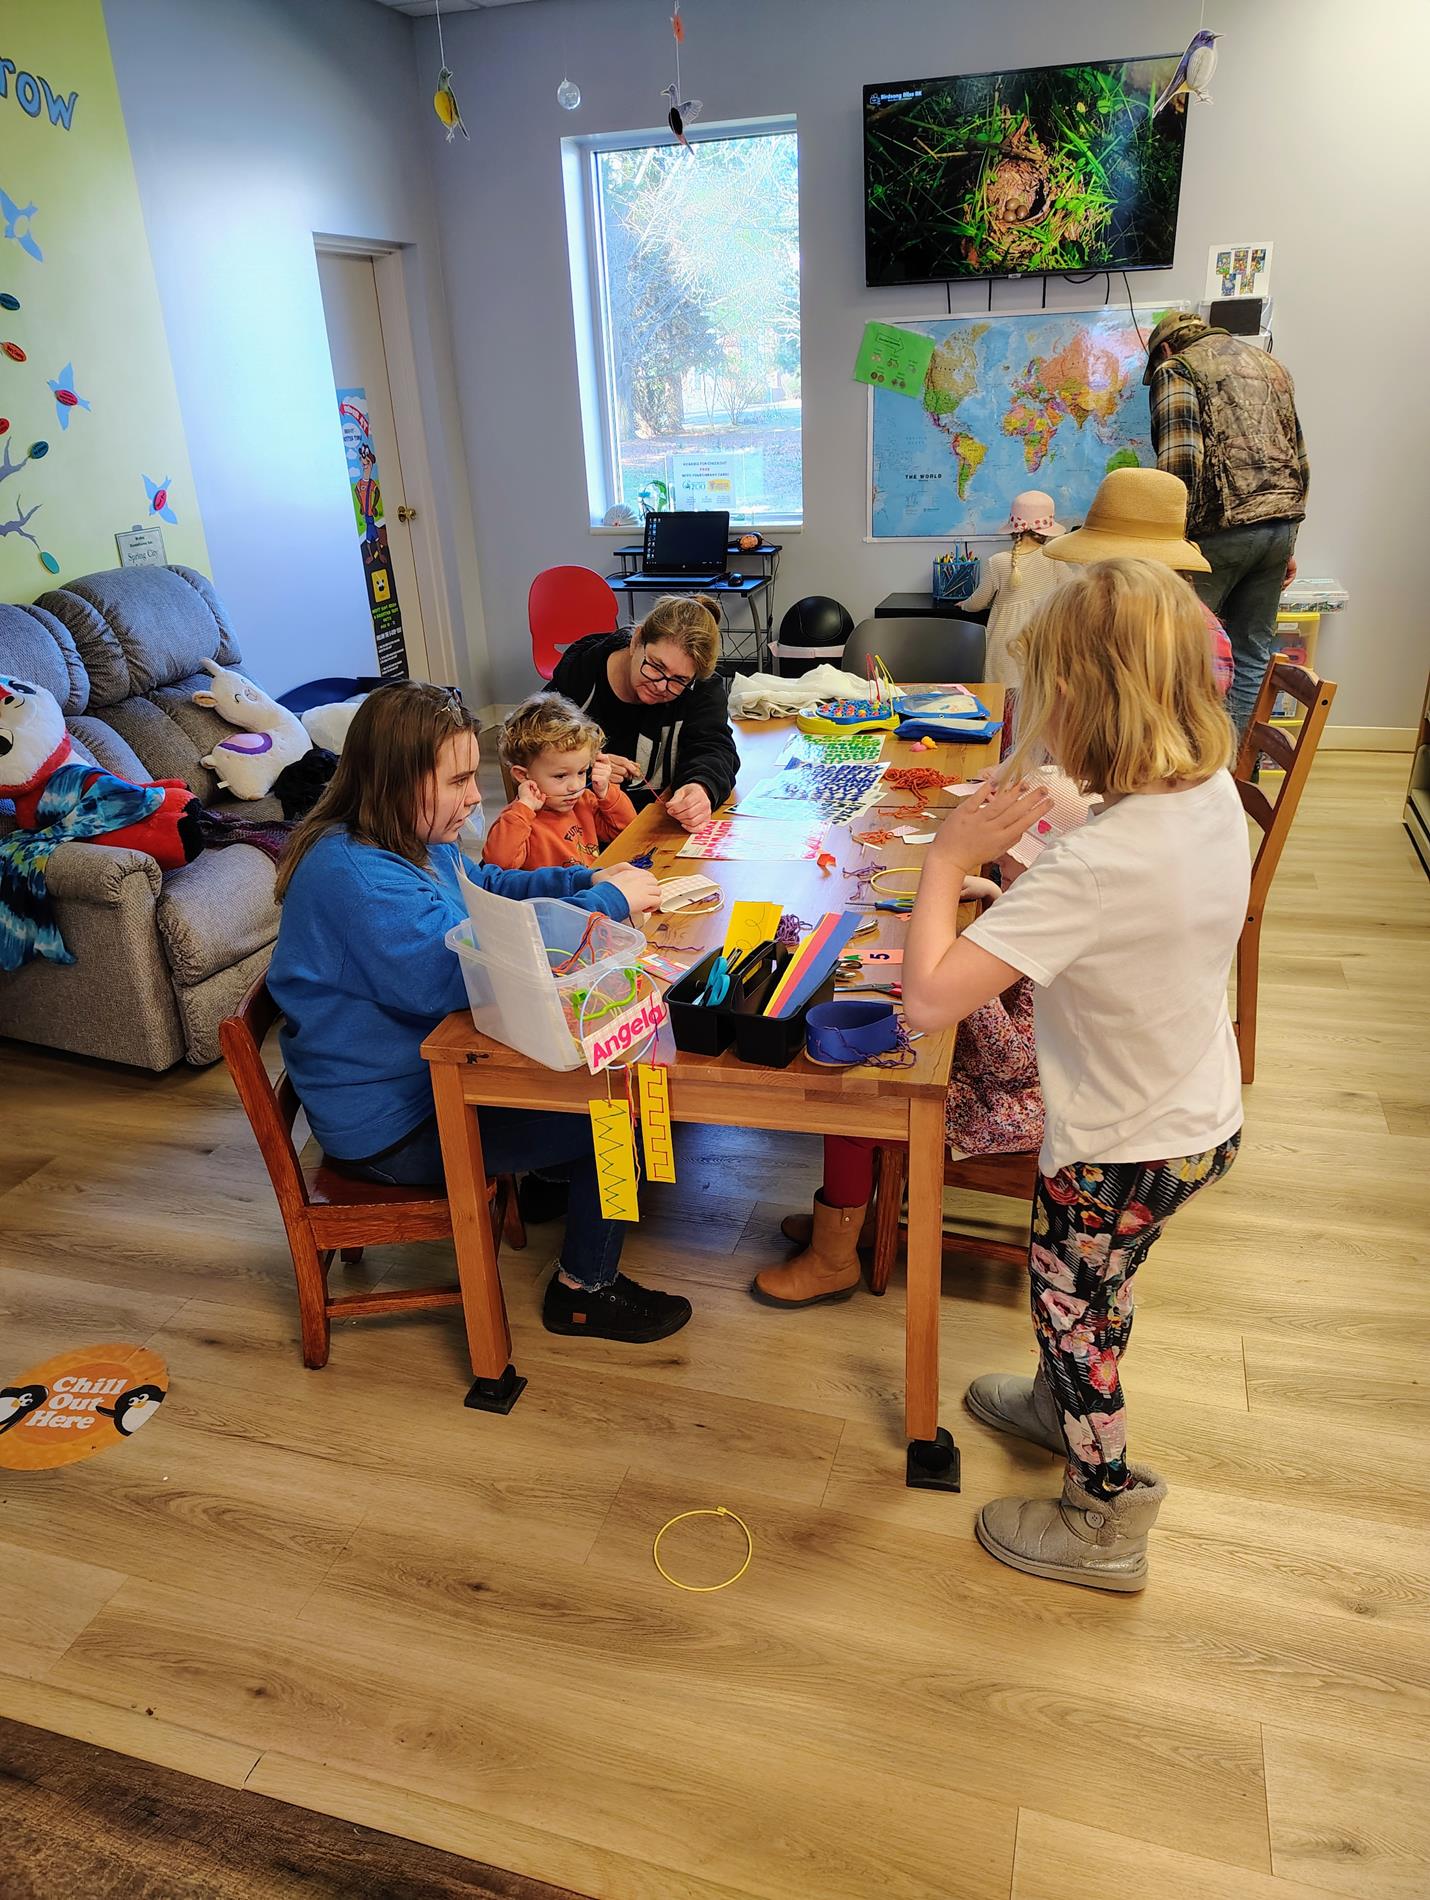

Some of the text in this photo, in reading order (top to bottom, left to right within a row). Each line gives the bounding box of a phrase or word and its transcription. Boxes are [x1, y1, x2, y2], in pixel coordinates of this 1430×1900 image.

[127, 549, 158, 563] Spring City
[869, 953, 890, 961] 5
[593, 1004, 664, 1069] Angela
[52, 1376, 128, 1395] Chill
[48, 1393, 104, 1412] Out
[24, 1410, 96, 1430] Here
